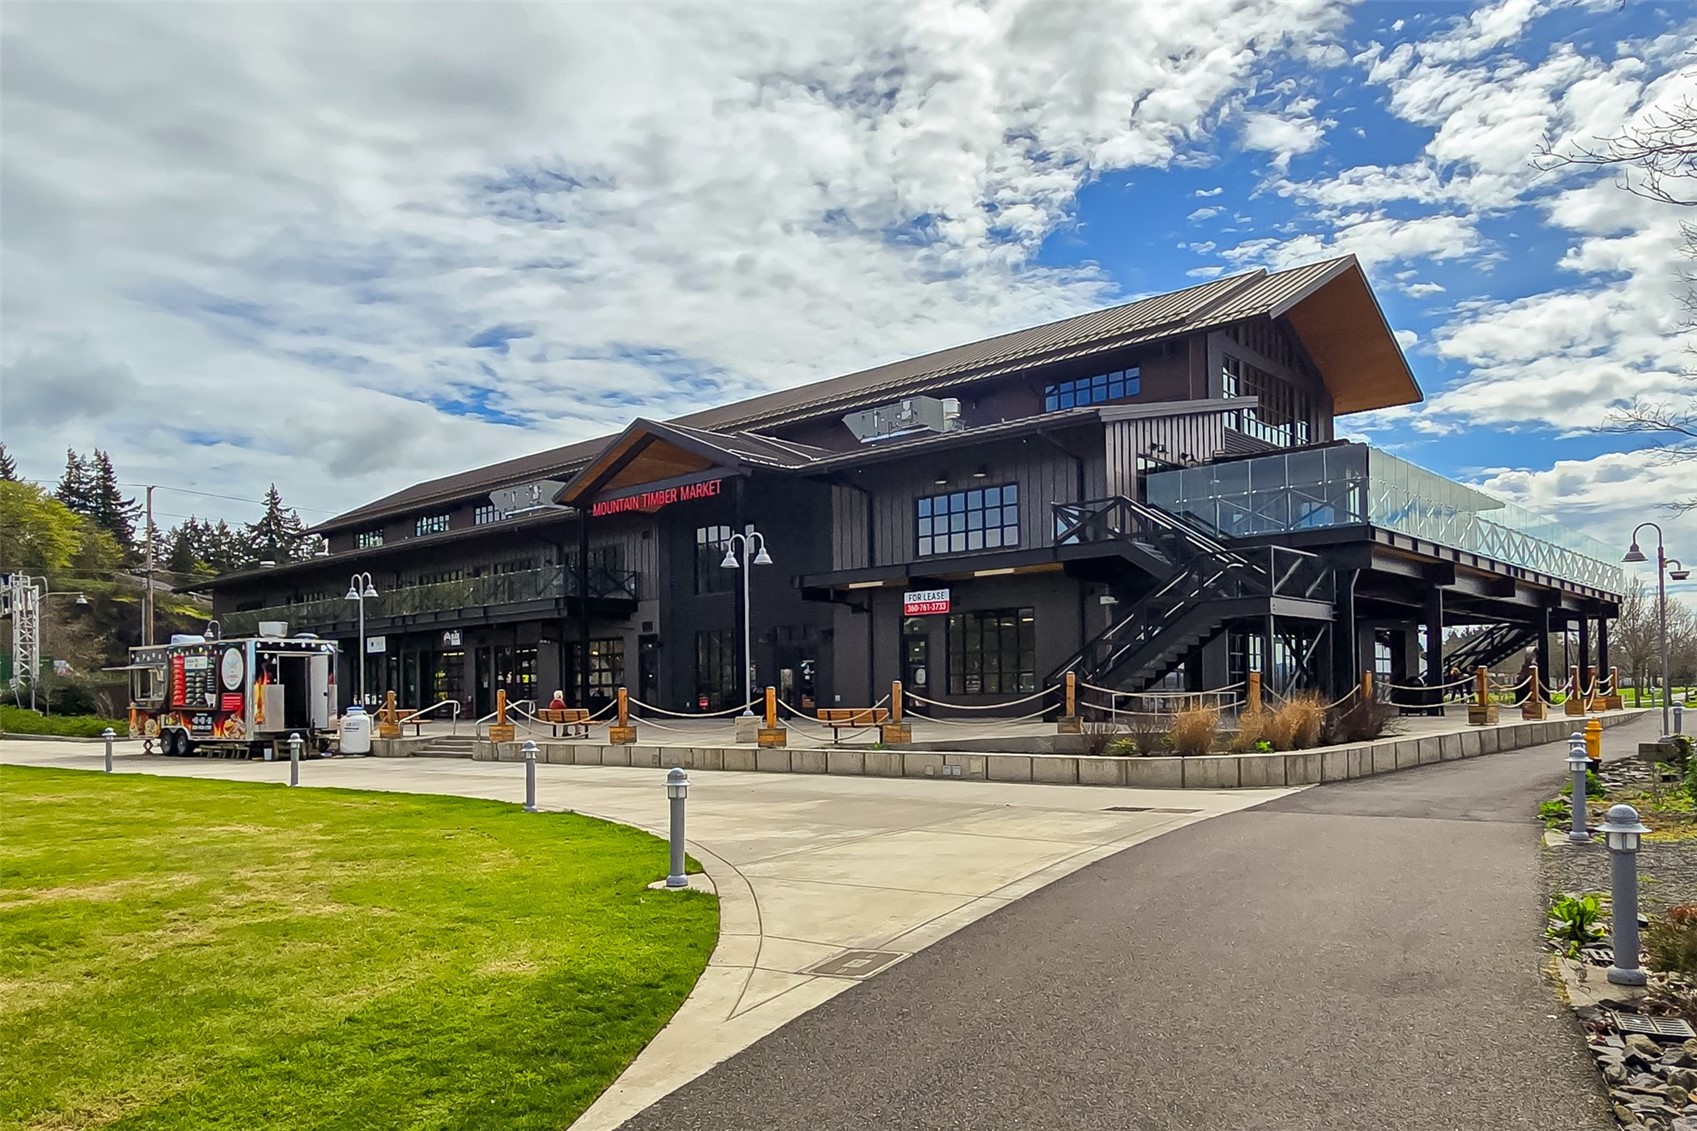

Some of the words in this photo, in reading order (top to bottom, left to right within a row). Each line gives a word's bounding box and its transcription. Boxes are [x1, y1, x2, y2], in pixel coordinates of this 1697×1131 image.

[593, 495, 639, 516] MOUNTAIN
[642, 488, 677, 507] TIMBER
[681, 479, 722, 500] MARKET
[908, 593, 922, 602] FOR
[923, 591, 945, 601] LEASE
[907, 602, 947, 613] 360-761-3733
